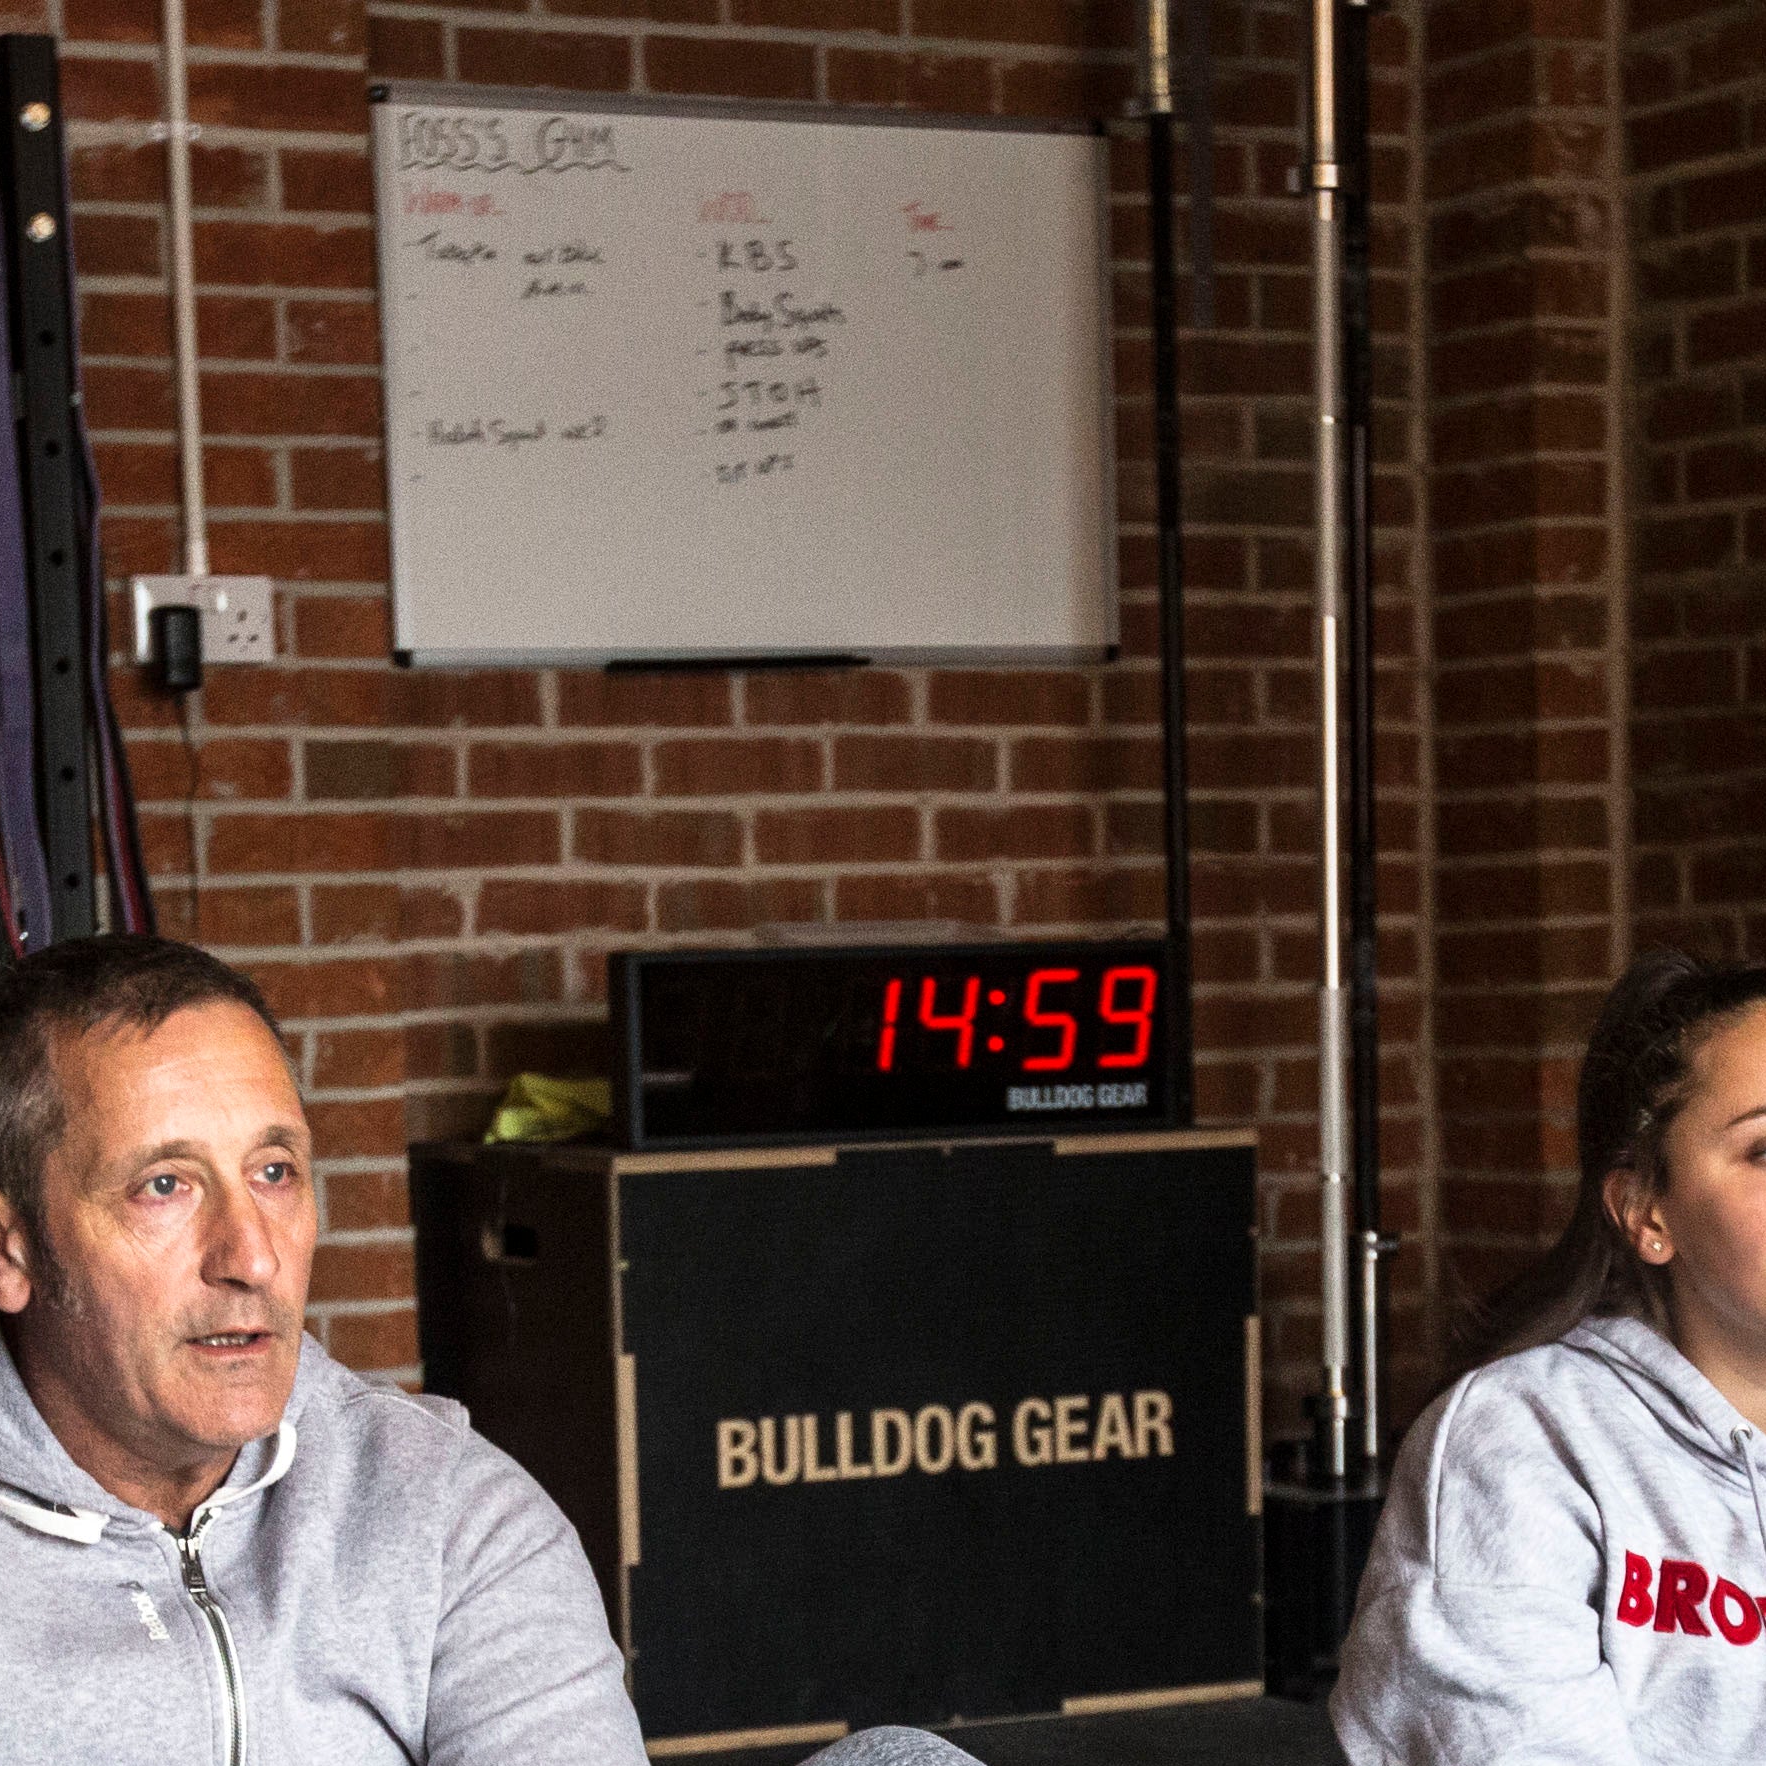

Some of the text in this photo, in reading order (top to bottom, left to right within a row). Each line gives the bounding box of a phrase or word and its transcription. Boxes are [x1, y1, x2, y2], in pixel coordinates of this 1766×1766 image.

[878, 966, 1157, 1072] 14:59
[1006, 1082, 1148, 1112] BULLDOG GEAR
[717, 1388, 1175, 1490] BULLDOG GEAR
